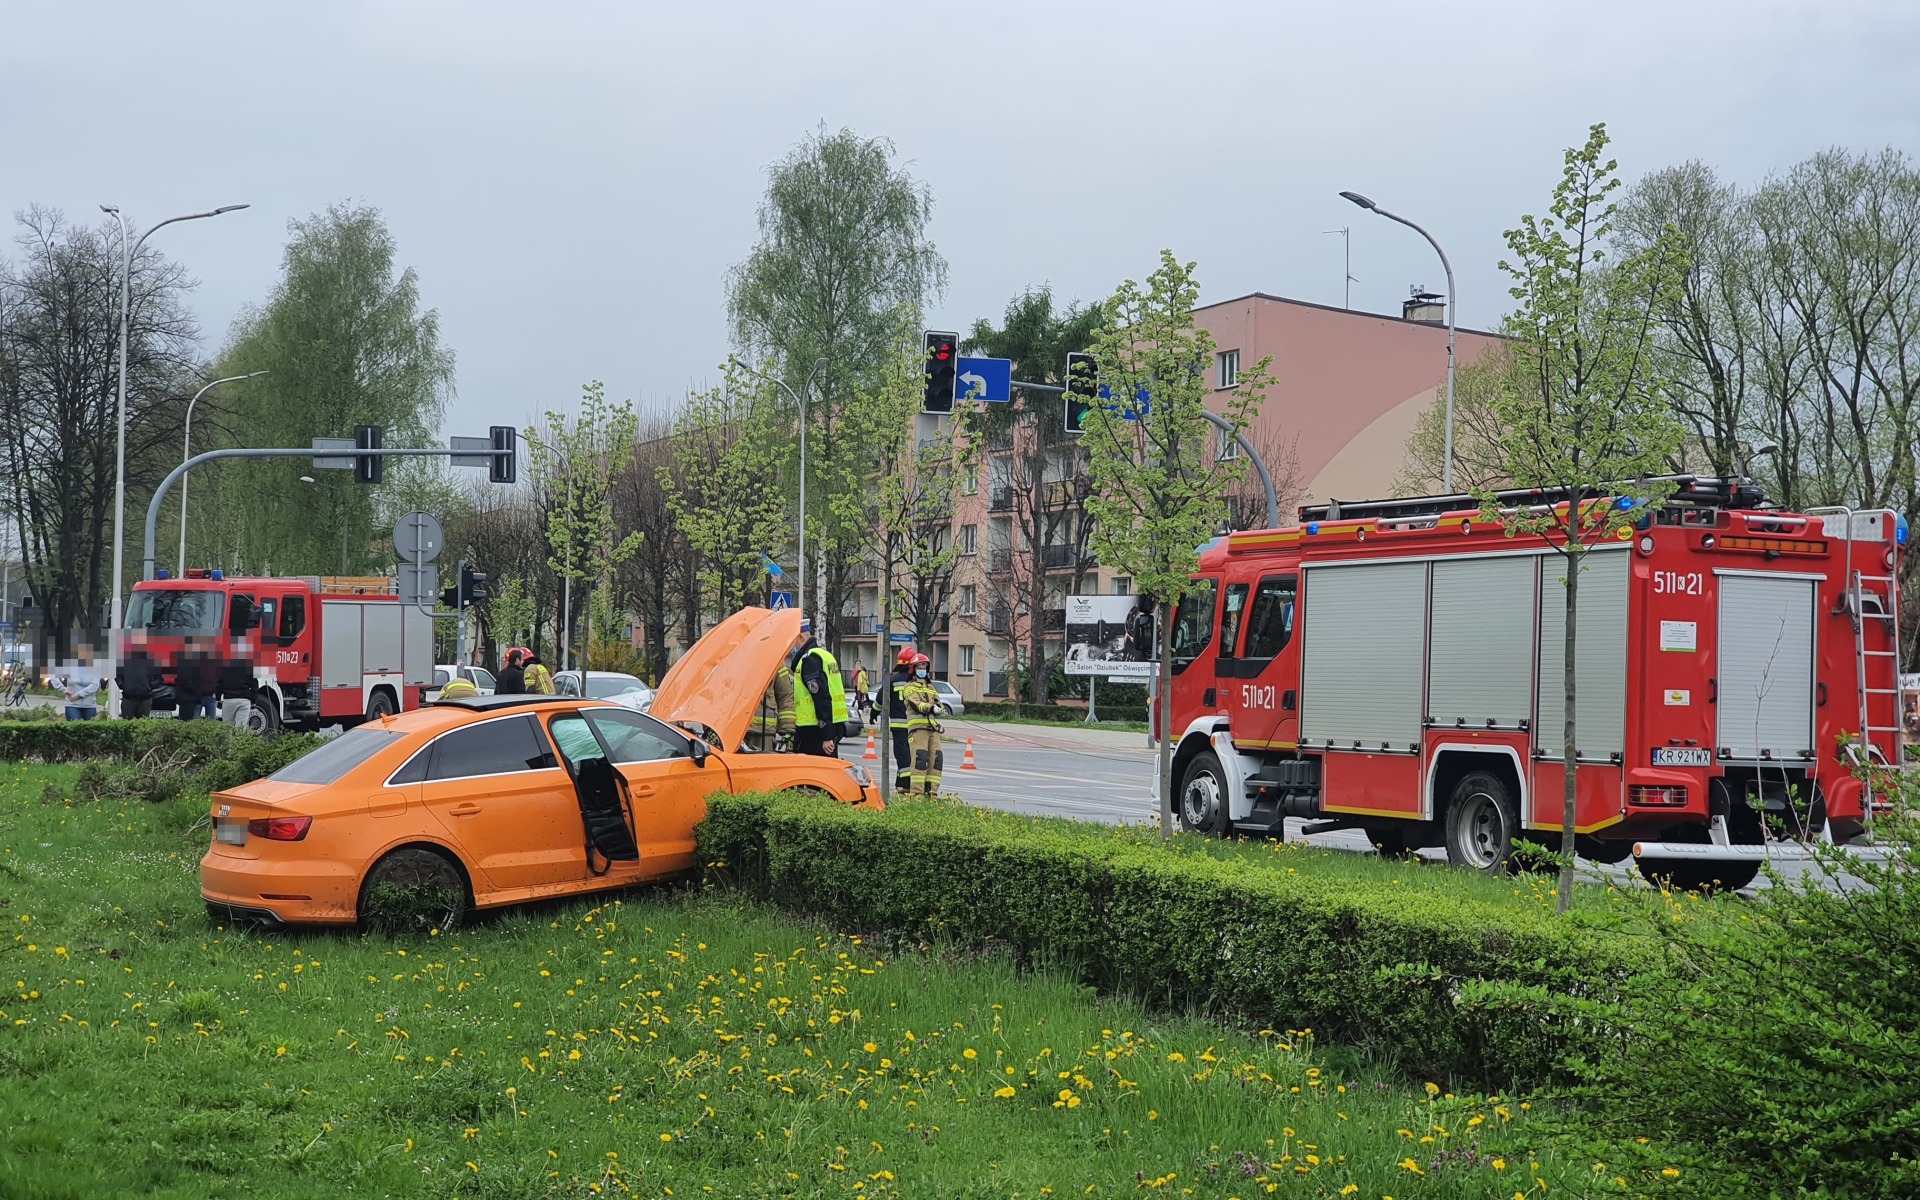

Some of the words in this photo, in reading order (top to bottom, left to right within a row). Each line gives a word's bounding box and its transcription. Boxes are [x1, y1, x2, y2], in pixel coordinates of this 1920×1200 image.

[277, 650, 299, 664] 51123
[1659, 750, 1674, 763] KR
[1677, 750, 1709, 763] 921WX
